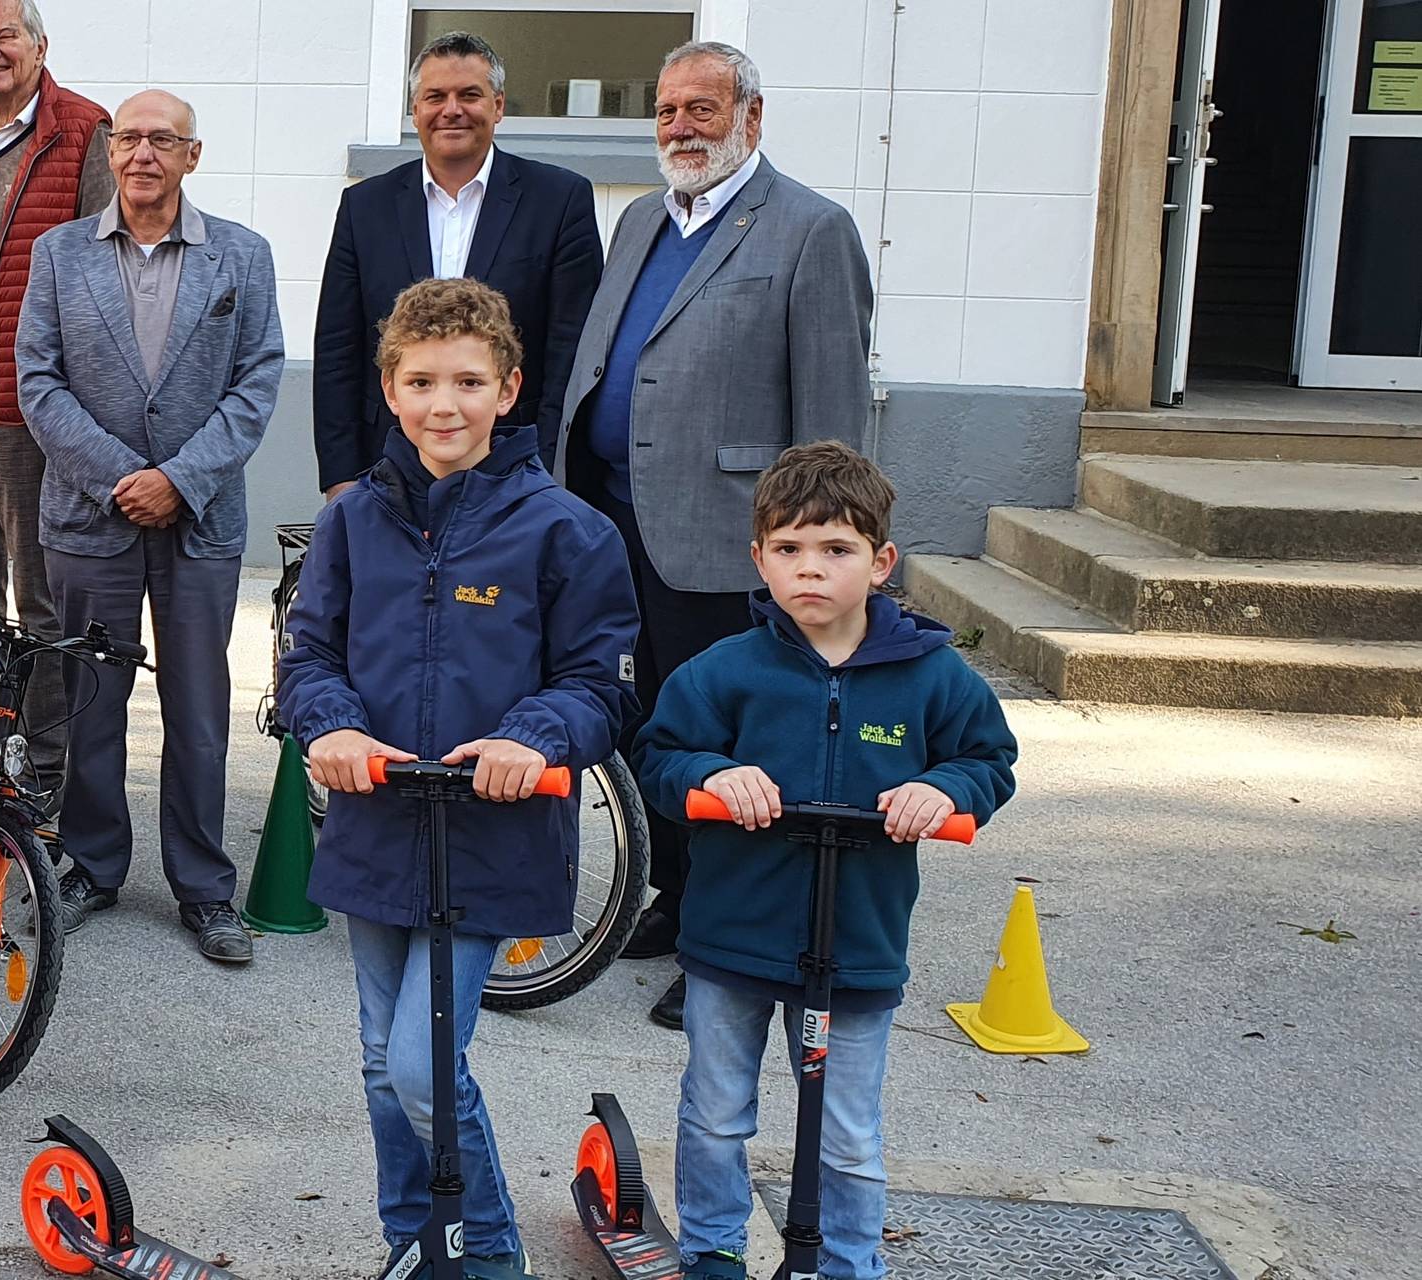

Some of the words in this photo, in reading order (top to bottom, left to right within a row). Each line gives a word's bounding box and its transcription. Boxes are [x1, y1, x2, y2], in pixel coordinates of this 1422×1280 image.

[859, 723, 885, 734] Jack
[859, 731, 902, 746] Wolfskin
[804, 1013, 817, 1044] MID
[819, 1015, 829, 1033] 7
[396, 1252, 418, 1279] oxelo
